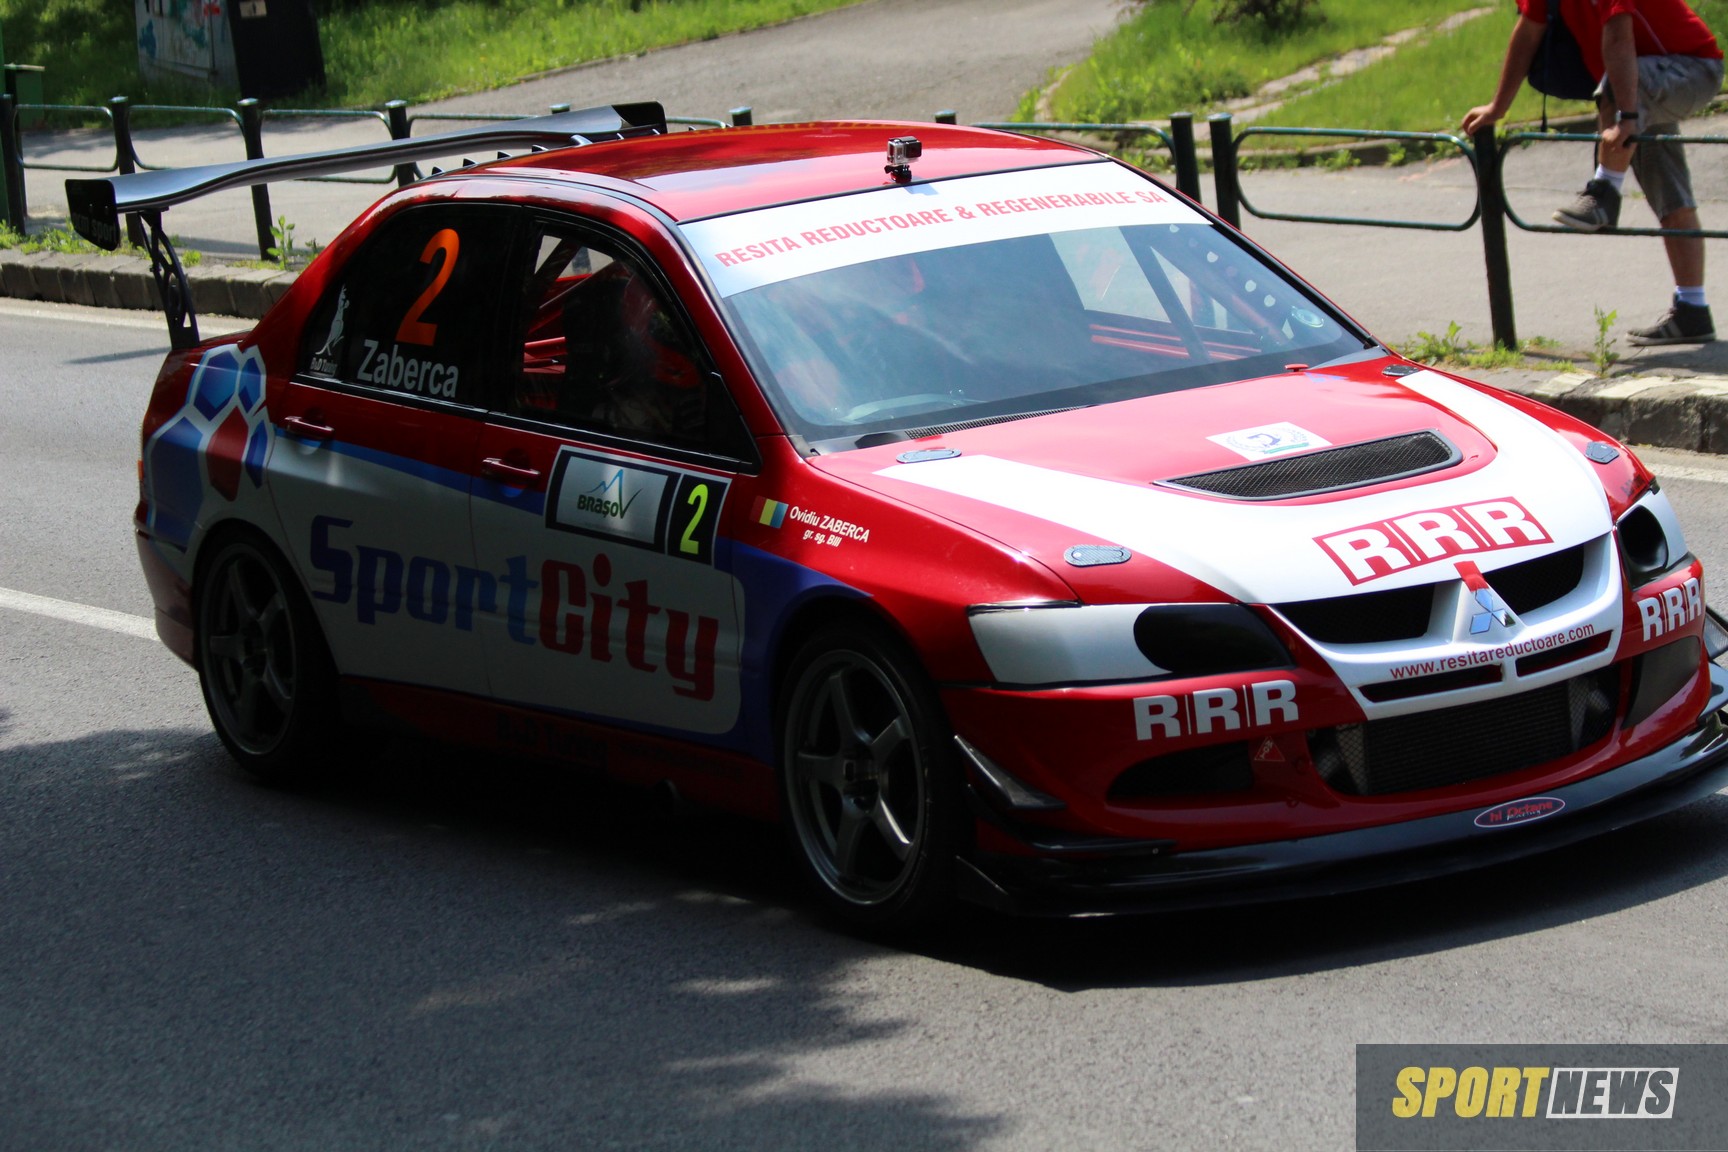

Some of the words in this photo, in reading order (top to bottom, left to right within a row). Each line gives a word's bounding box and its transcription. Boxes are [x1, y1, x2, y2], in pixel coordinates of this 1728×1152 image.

[714, 236, 802, 268] RESITA
[800, 208, 954, 246] REDUCTOARE
[955, 204, 976, 221] &
[976, 190, 1136, 217] REGENERABILE
[1135, 190, 1168, 204] SA
[394, 228, 461, 347] 2
[356, 338, 460, 398] Zaberca
[679, 483, 709, 555] 2
[789, 505, 821, 527] Ovidiu
[819, 514, 871, 543] ZABERCA
[802, 528, 814, 541] gr.
[813, 531, 826, 545] sg.
[1318, 499, 1550, 583] RRR
[1637, 576, 1701, 643] RRR
[1389, 620, 1595, 681] www.resitareductoare.com
[1132, 679, 1300, 742] RRR
